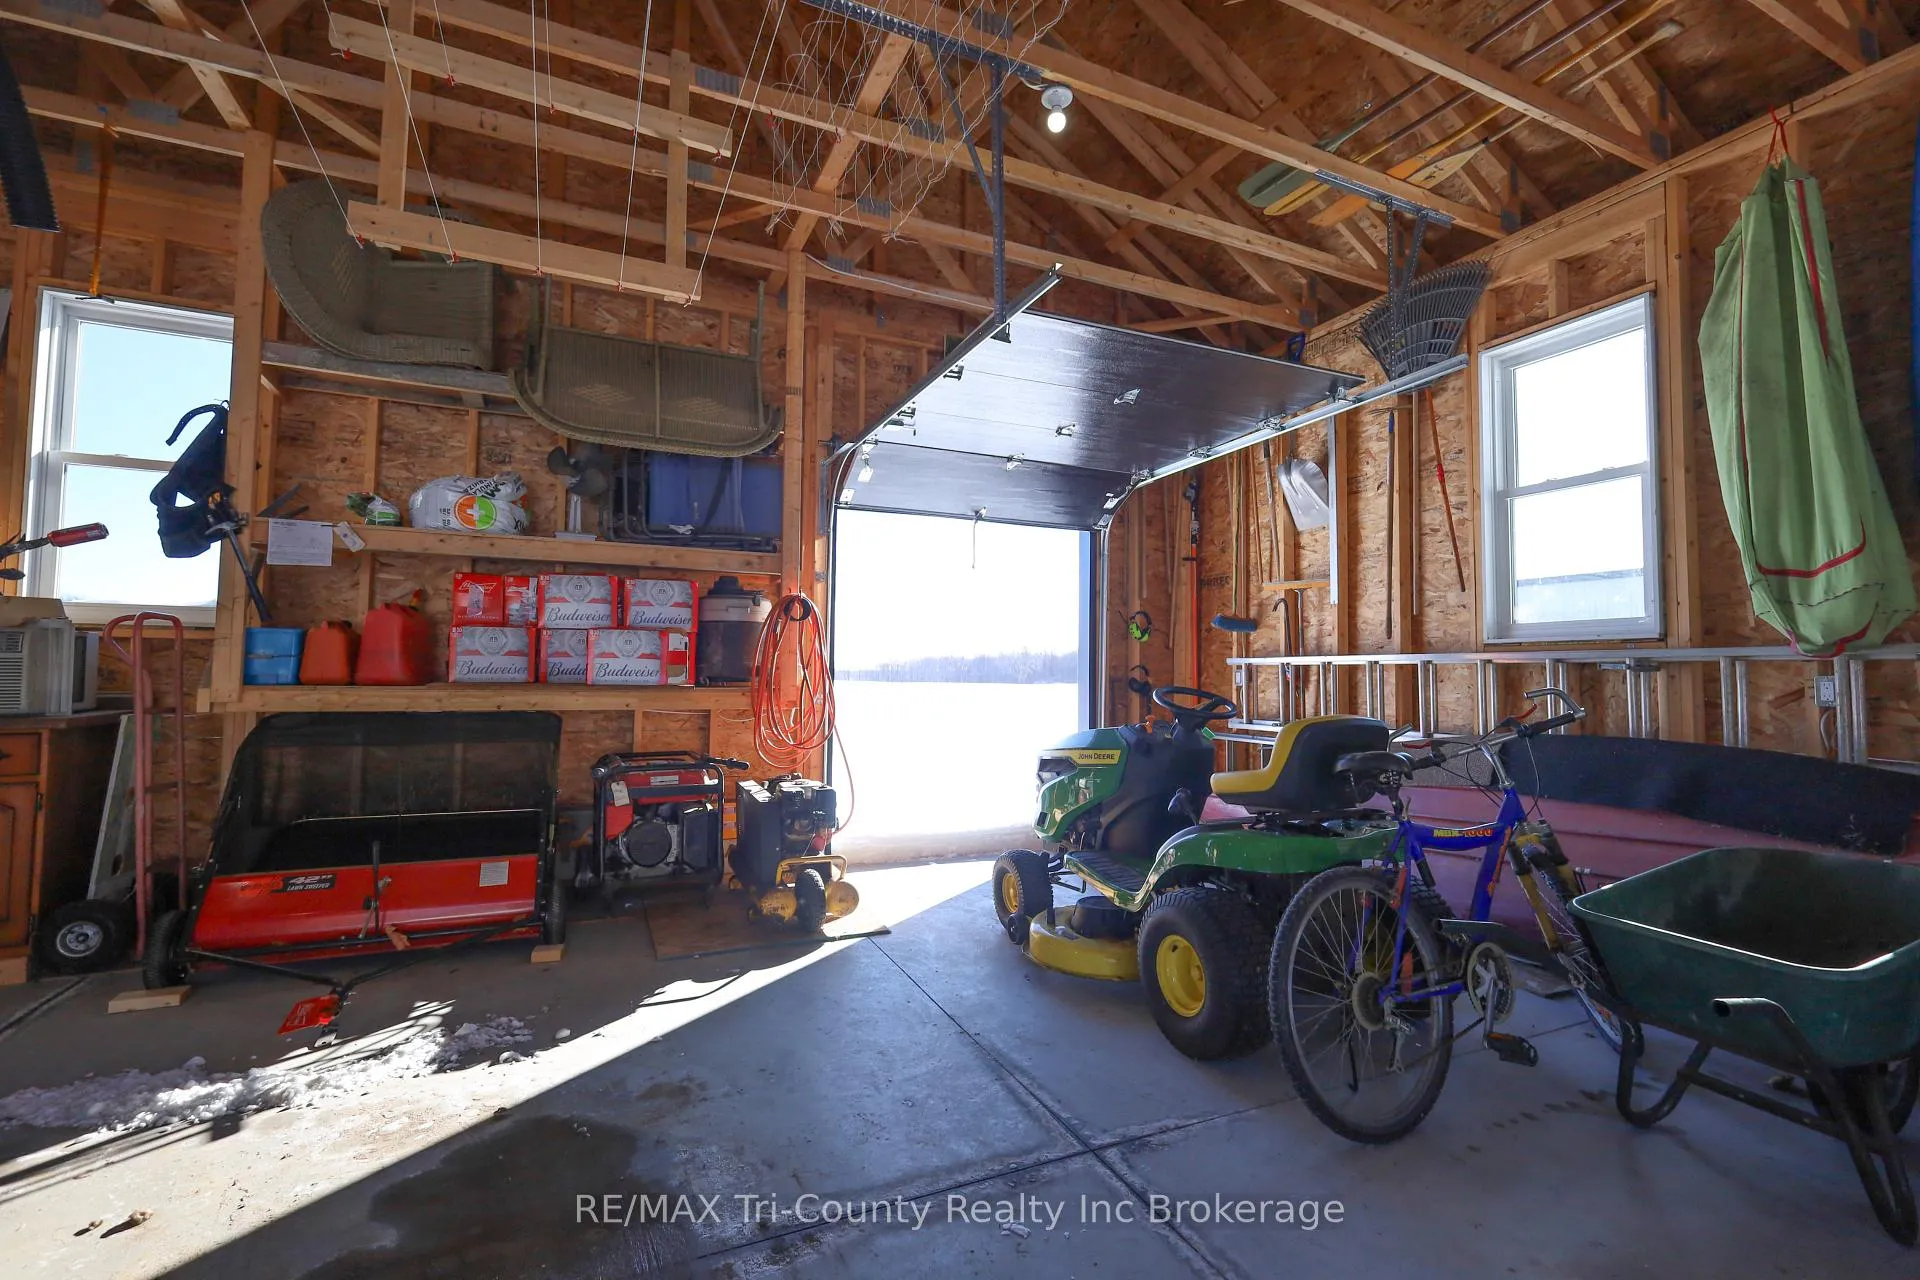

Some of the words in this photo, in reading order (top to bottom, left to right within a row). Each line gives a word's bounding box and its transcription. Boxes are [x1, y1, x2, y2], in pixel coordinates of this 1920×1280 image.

[547, 607, 610, 622] Budweiser
[632, 610, 691, 625] Budweiser
[459, 660, 528, 676] Budweiser
[595, 661, 661, 678] Budweiser
[1093, 752, 1115, 760] DEERE
[286, 884, 304, 892] LAWN
